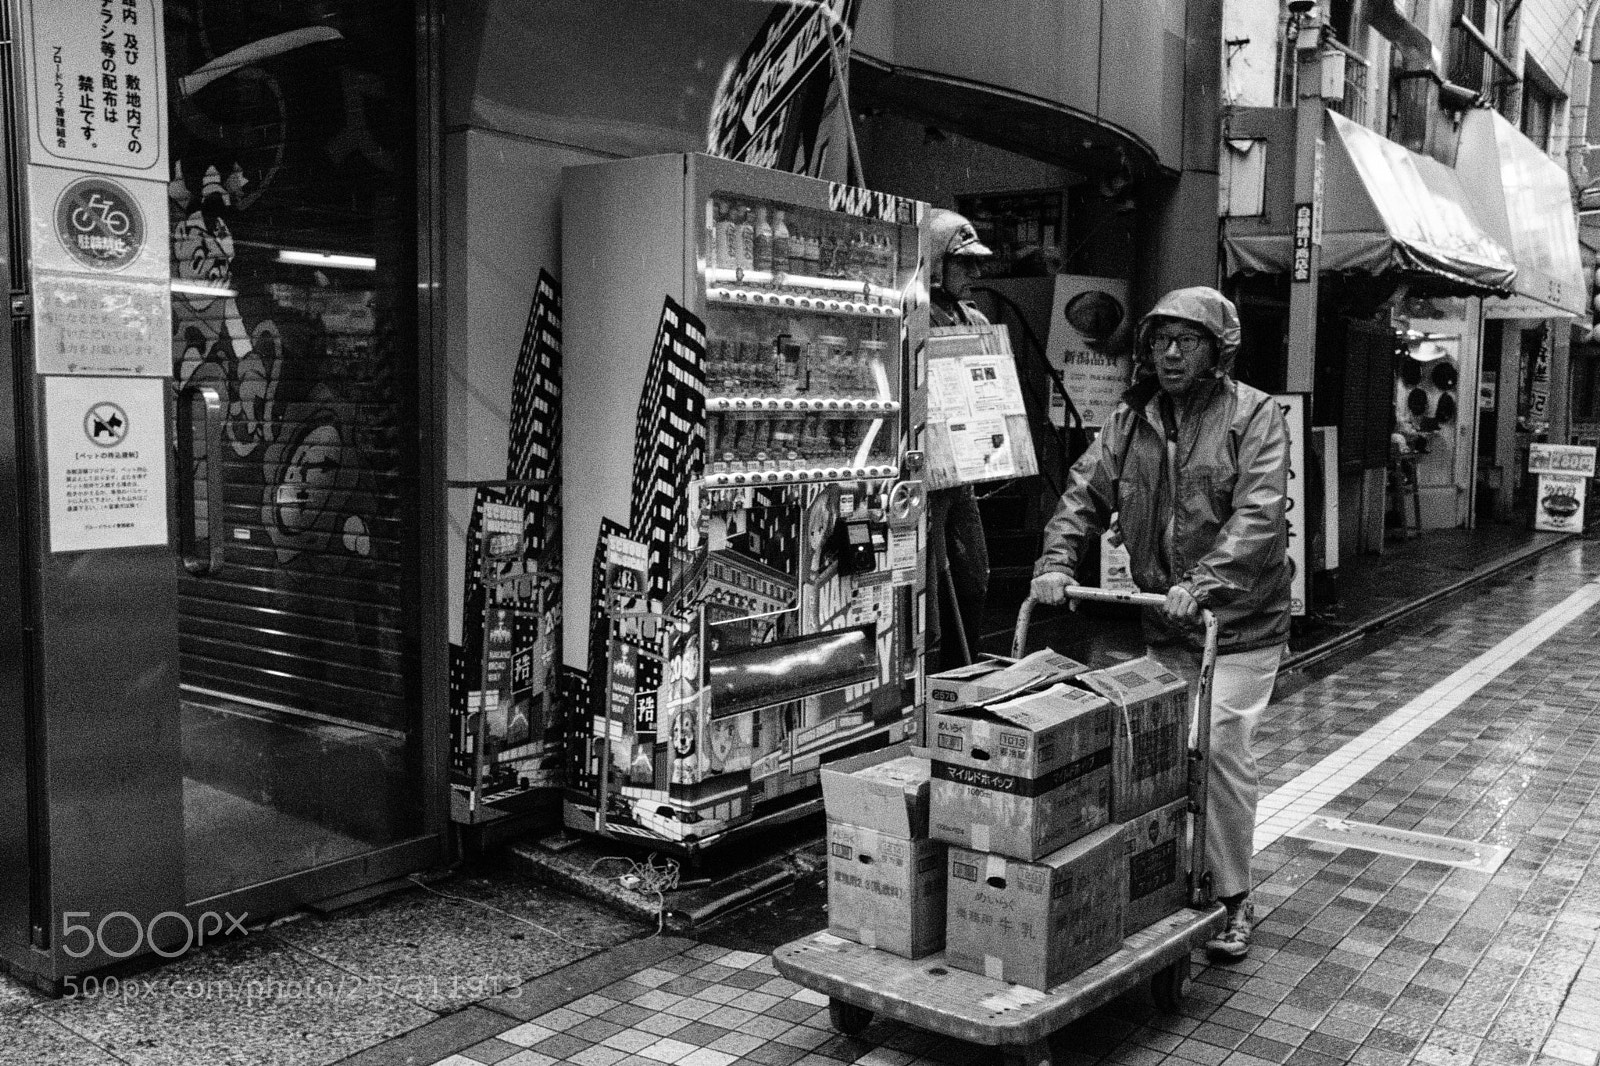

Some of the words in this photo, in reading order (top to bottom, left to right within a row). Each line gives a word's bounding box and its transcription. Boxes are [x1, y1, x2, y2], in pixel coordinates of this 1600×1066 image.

[124, 33, 139, 65] 及び
[752, 53, 787, 117] ONE
[78, 74, 98, 149] 禁止です。
[125, 74, 142, 154] 敷地内での
[1002, 734, 1026, 748] 1013
[947, 766, 1015, 790] マイルドホイップ
